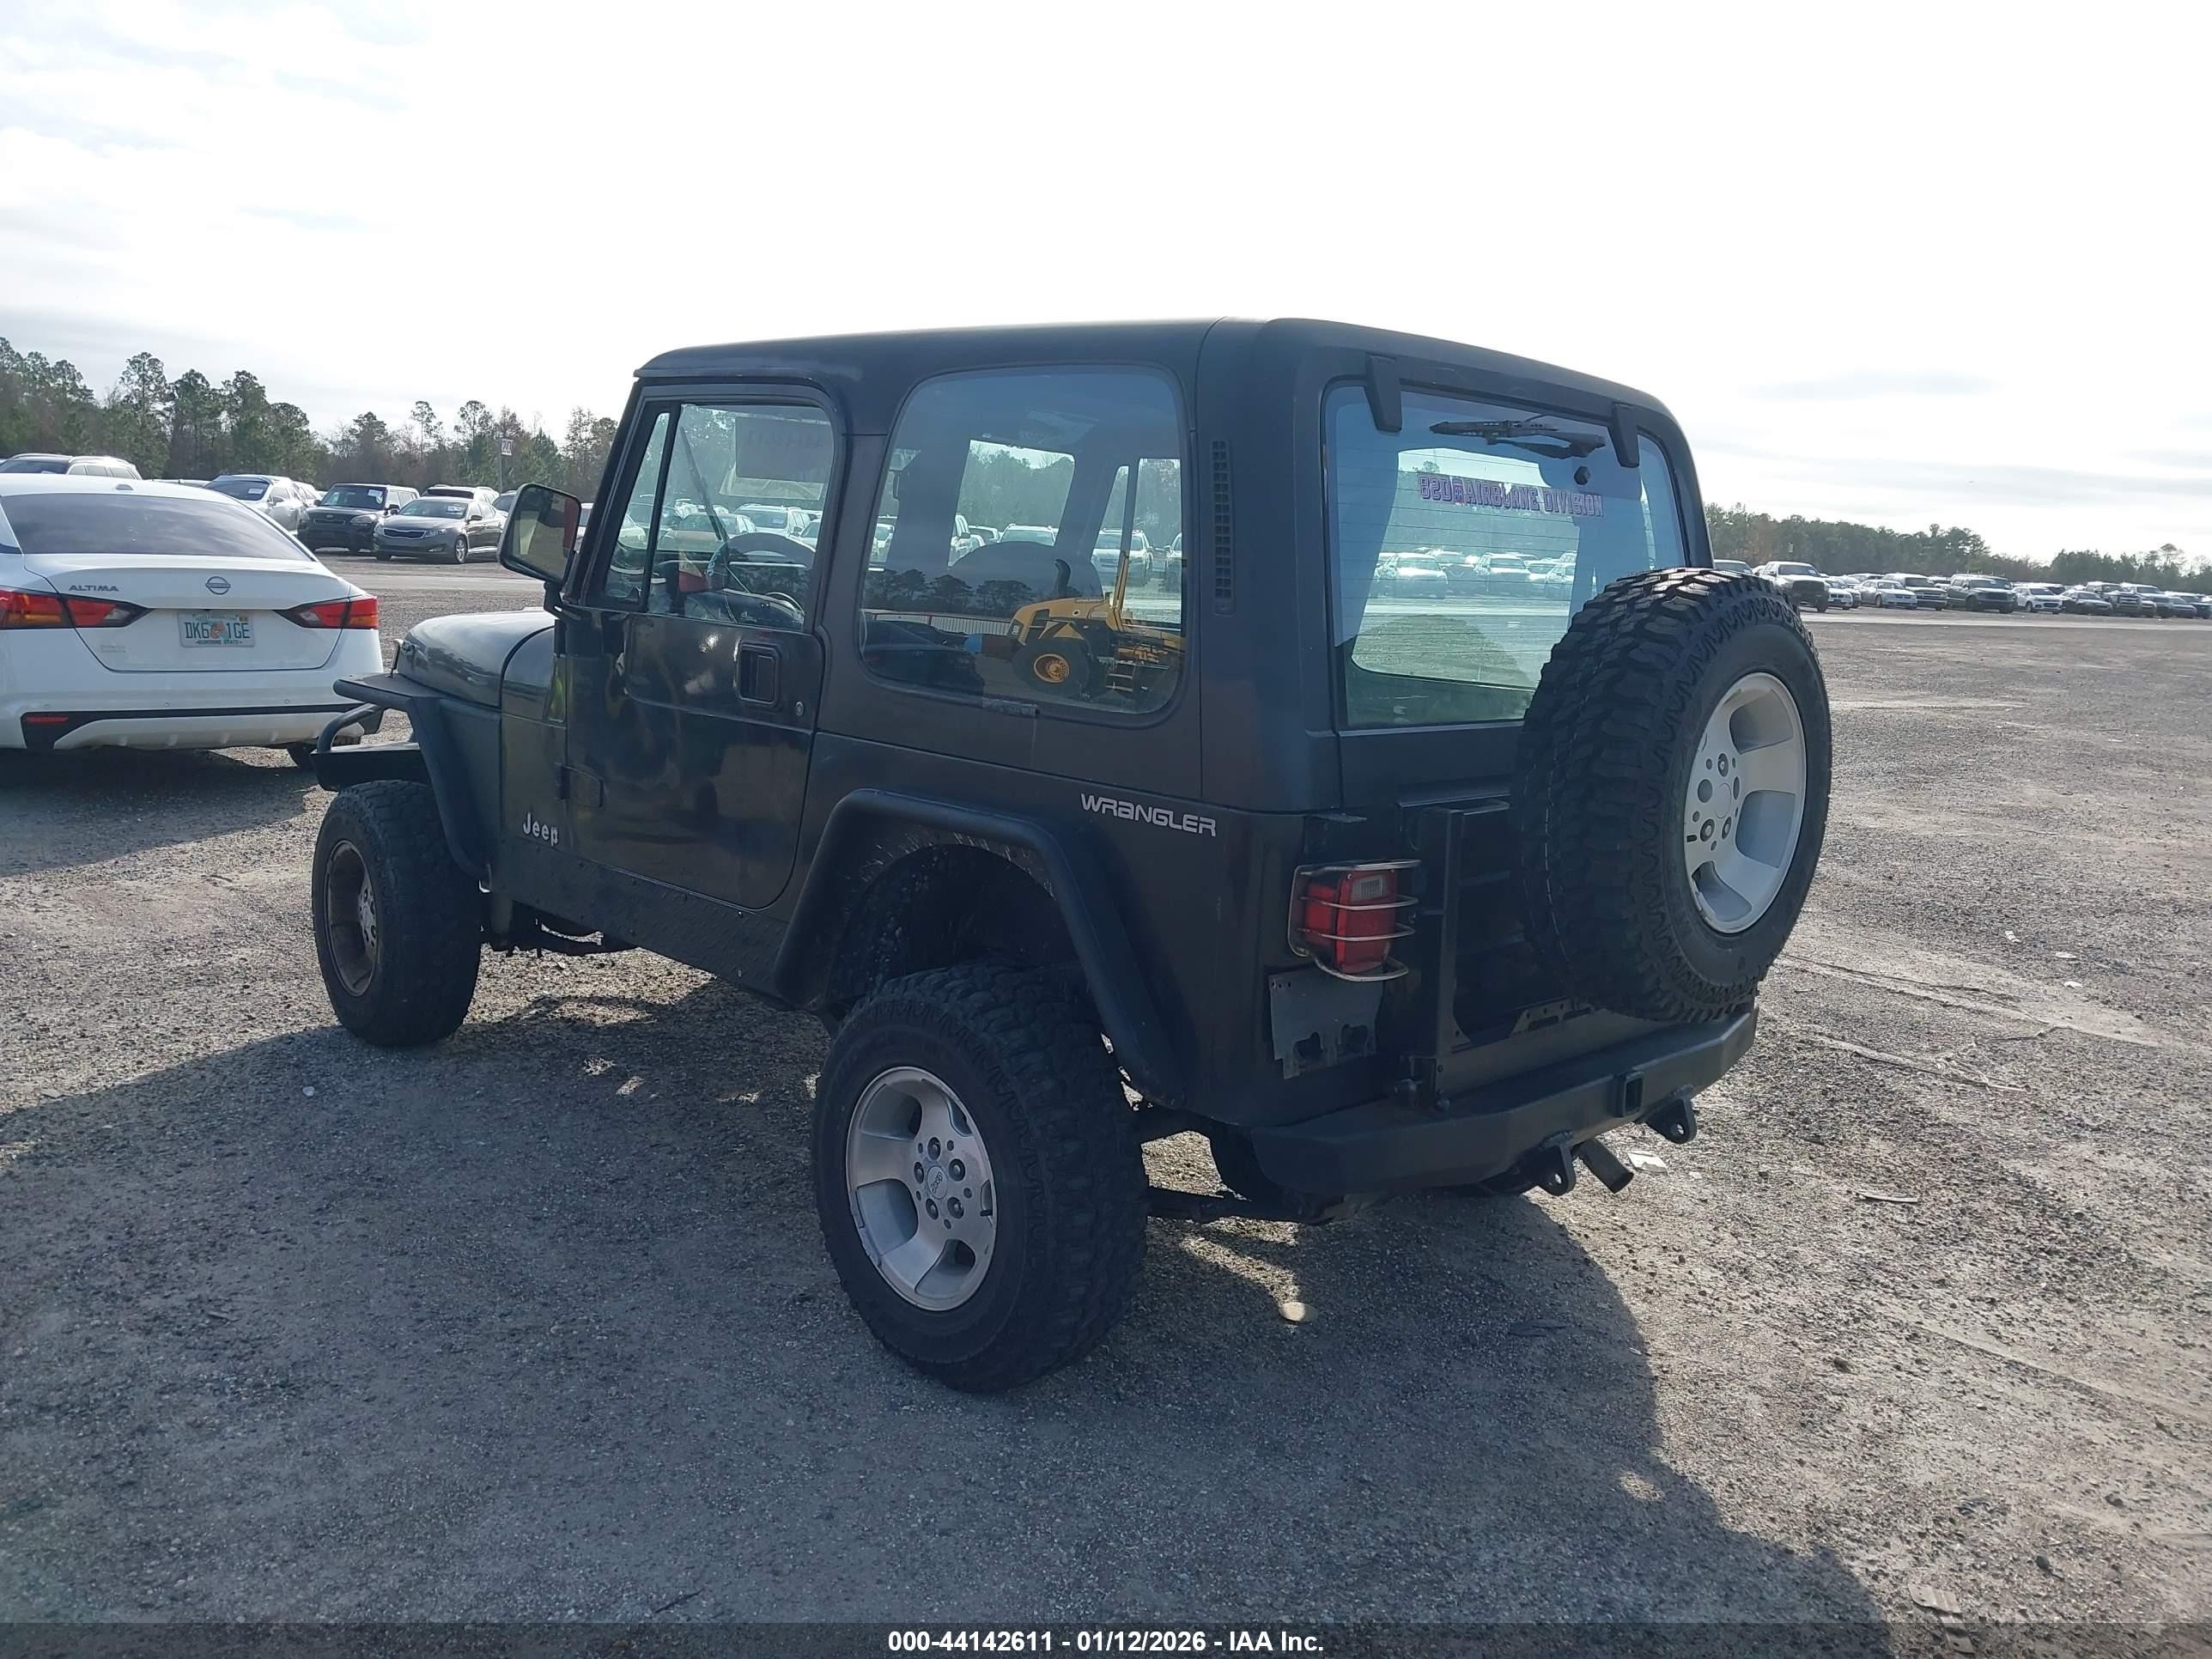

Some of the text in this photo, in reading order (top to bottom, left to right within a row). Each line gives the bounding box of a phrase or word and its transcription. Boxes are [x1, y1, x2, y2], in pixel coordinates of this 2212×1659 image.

[1543, 489, 1604, 518] DIVISION
[184, 622, 251, 640] DK6 1GE
[523, 811, 558, 847] Jeep
